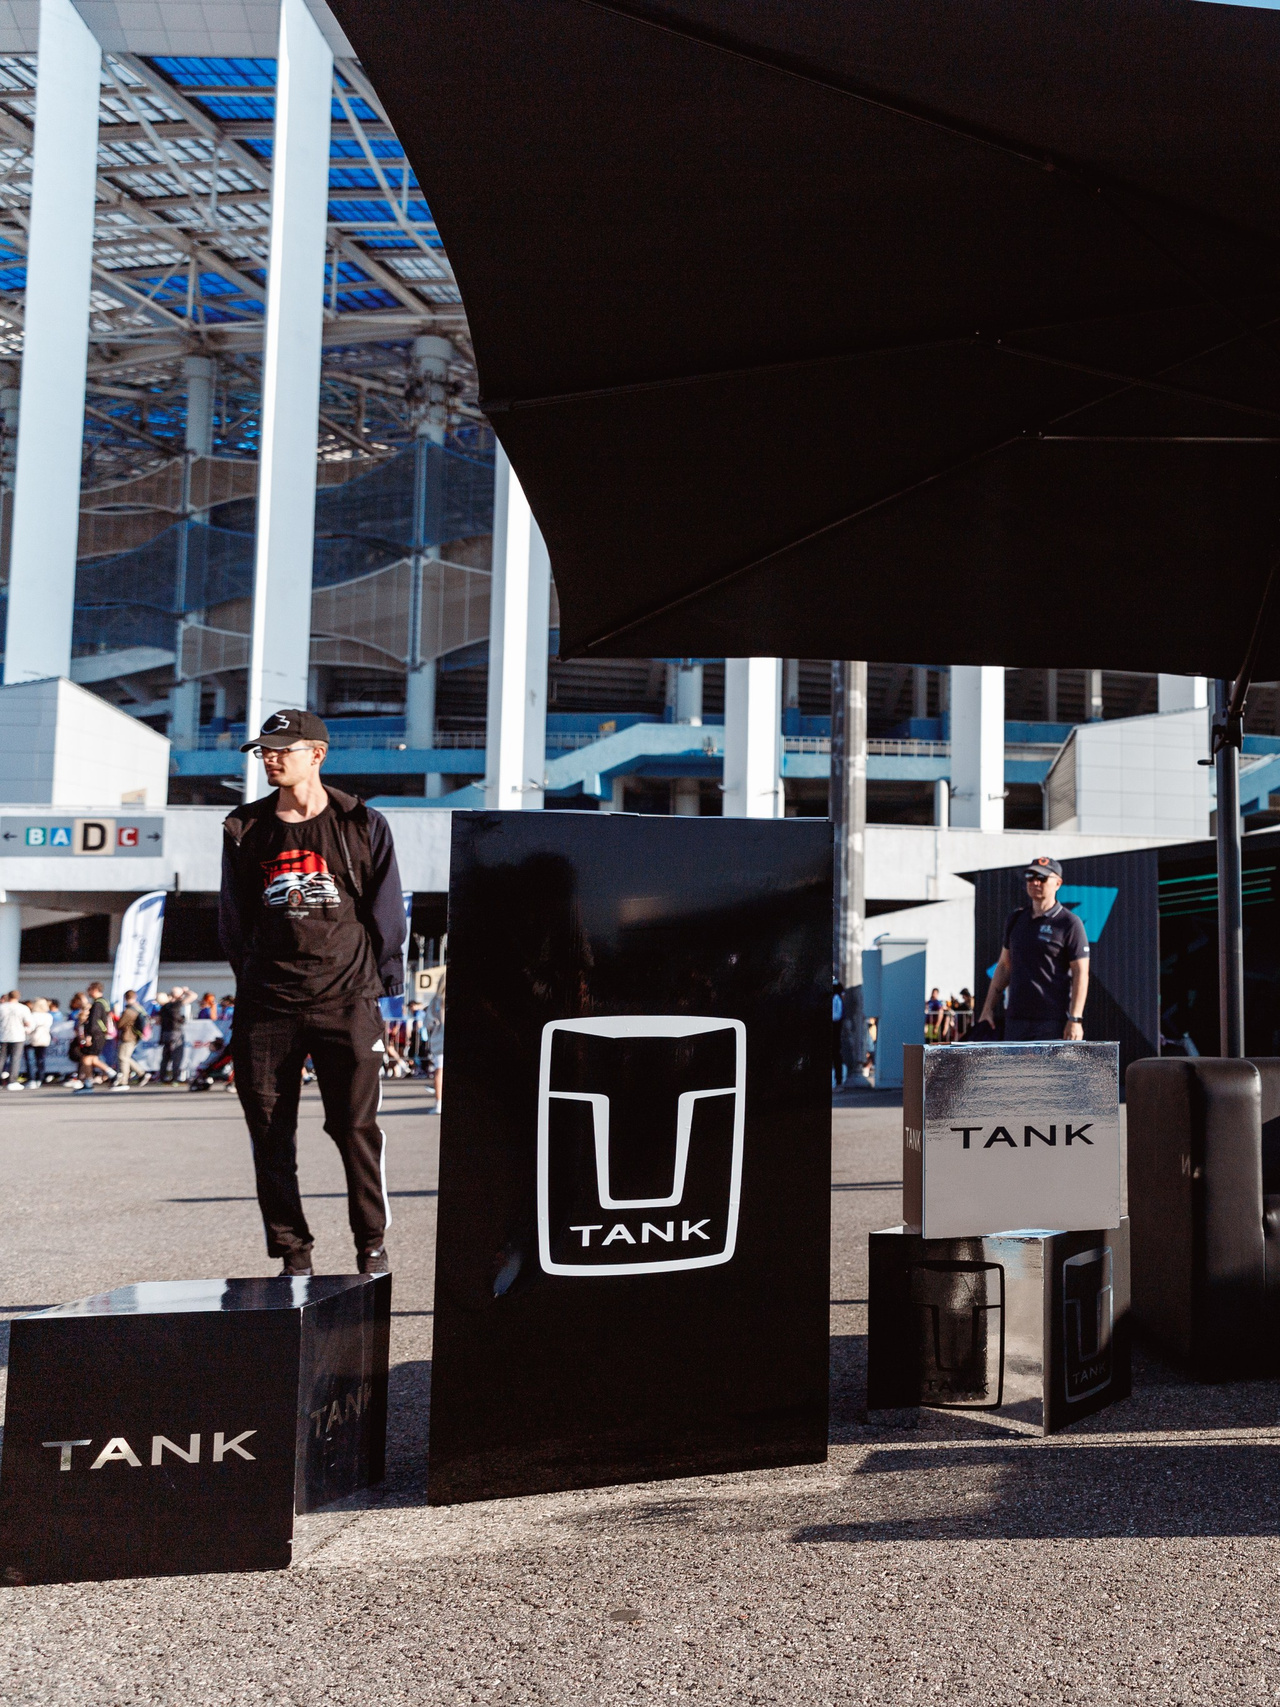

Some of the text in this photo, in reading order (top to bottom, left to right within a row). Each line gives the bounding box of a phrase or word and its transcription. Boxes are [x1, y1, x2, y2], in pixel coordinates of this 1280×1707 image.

[28, 822, 136, 852] B A D C
[419, 974, 432, 989] D
[950, 1123, 1095, 1150] TANK
[569, 1218, 711, 1247] TANK
[1072, 1362, 1106, 1386] TANK
[42, 1429, 258, 1472] TANK
